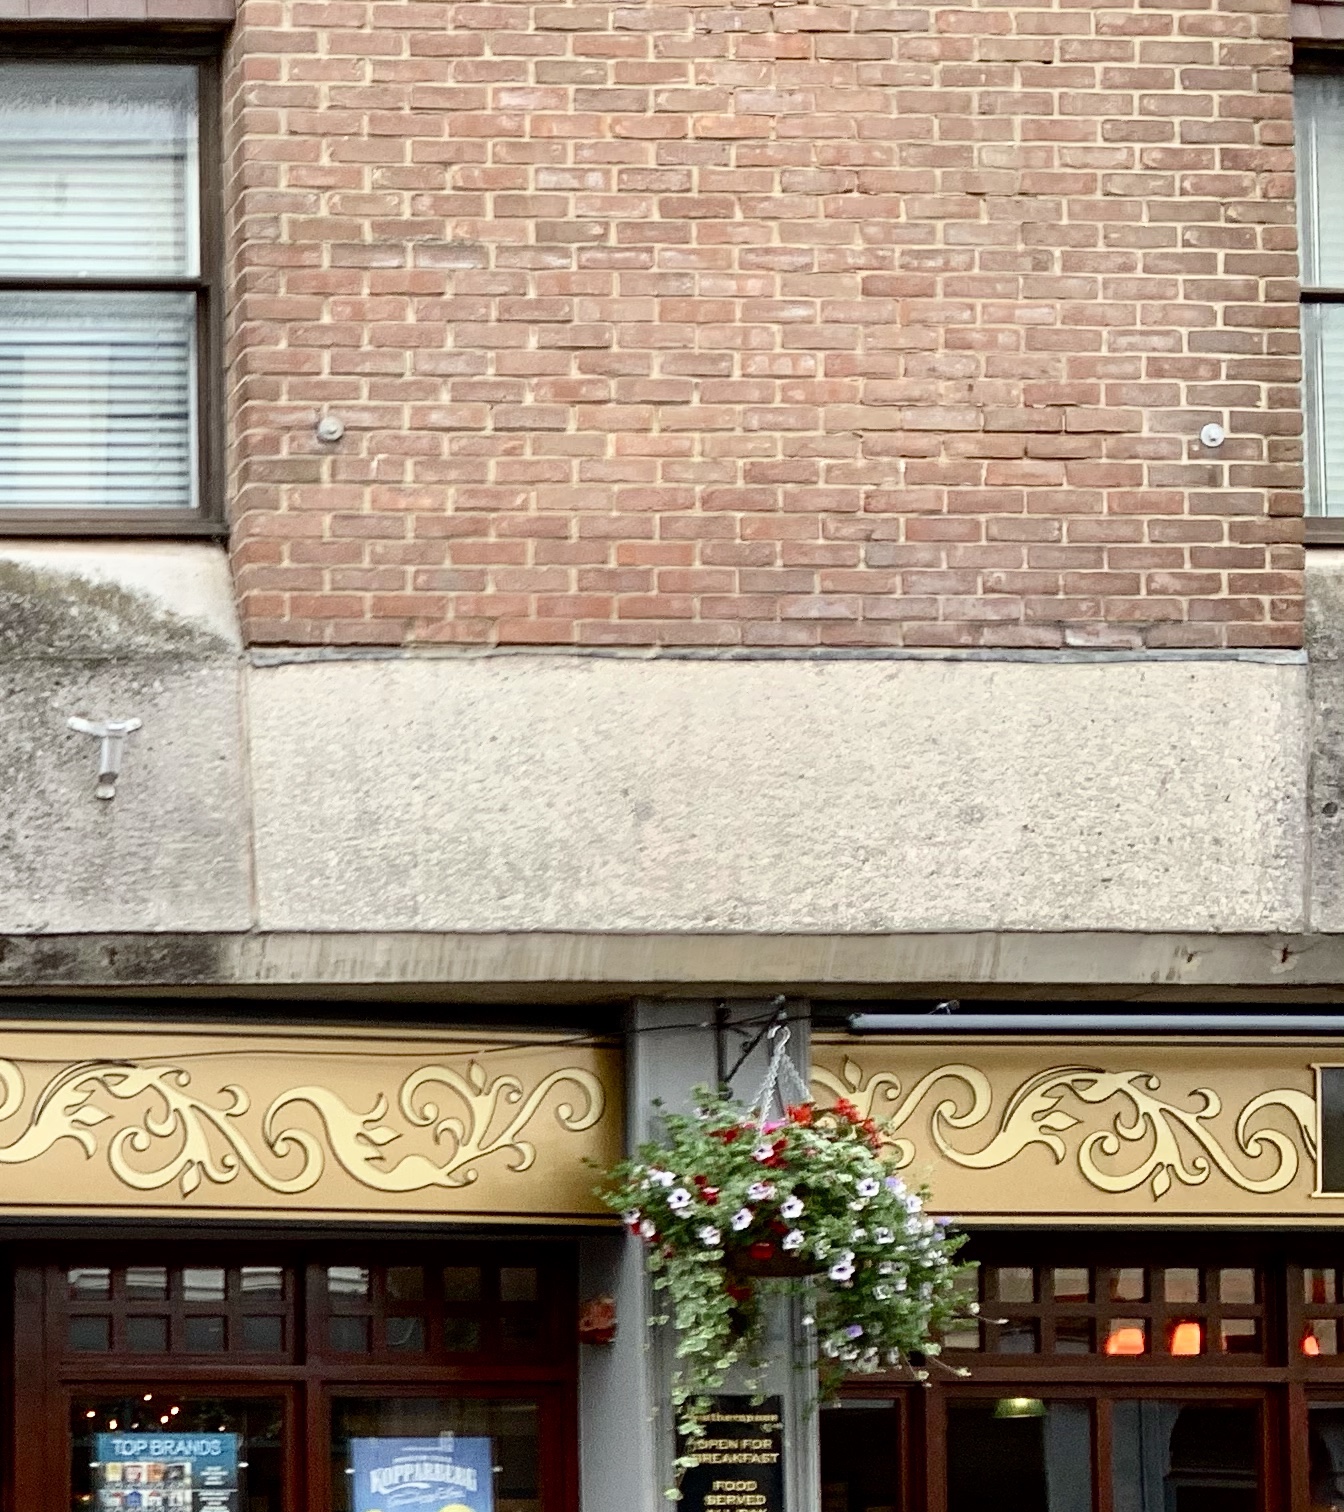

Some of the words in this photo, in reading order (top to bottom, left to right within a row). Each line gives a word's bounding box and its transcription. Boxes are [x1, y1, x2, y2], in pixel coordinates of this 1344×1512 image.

[112, 1439, 148, 1455] TOP
[149, 1439, 222, 1456] BRANDS
[696, 1439, 738, 1449] OPEN
[743, 1439, 773, 1449] FOR
[692, 1453, 780, 1463] BREAKFAST
[713, 1481, 758, 1491] FOOD
[704, 1495, 766, 1505] SERVED
